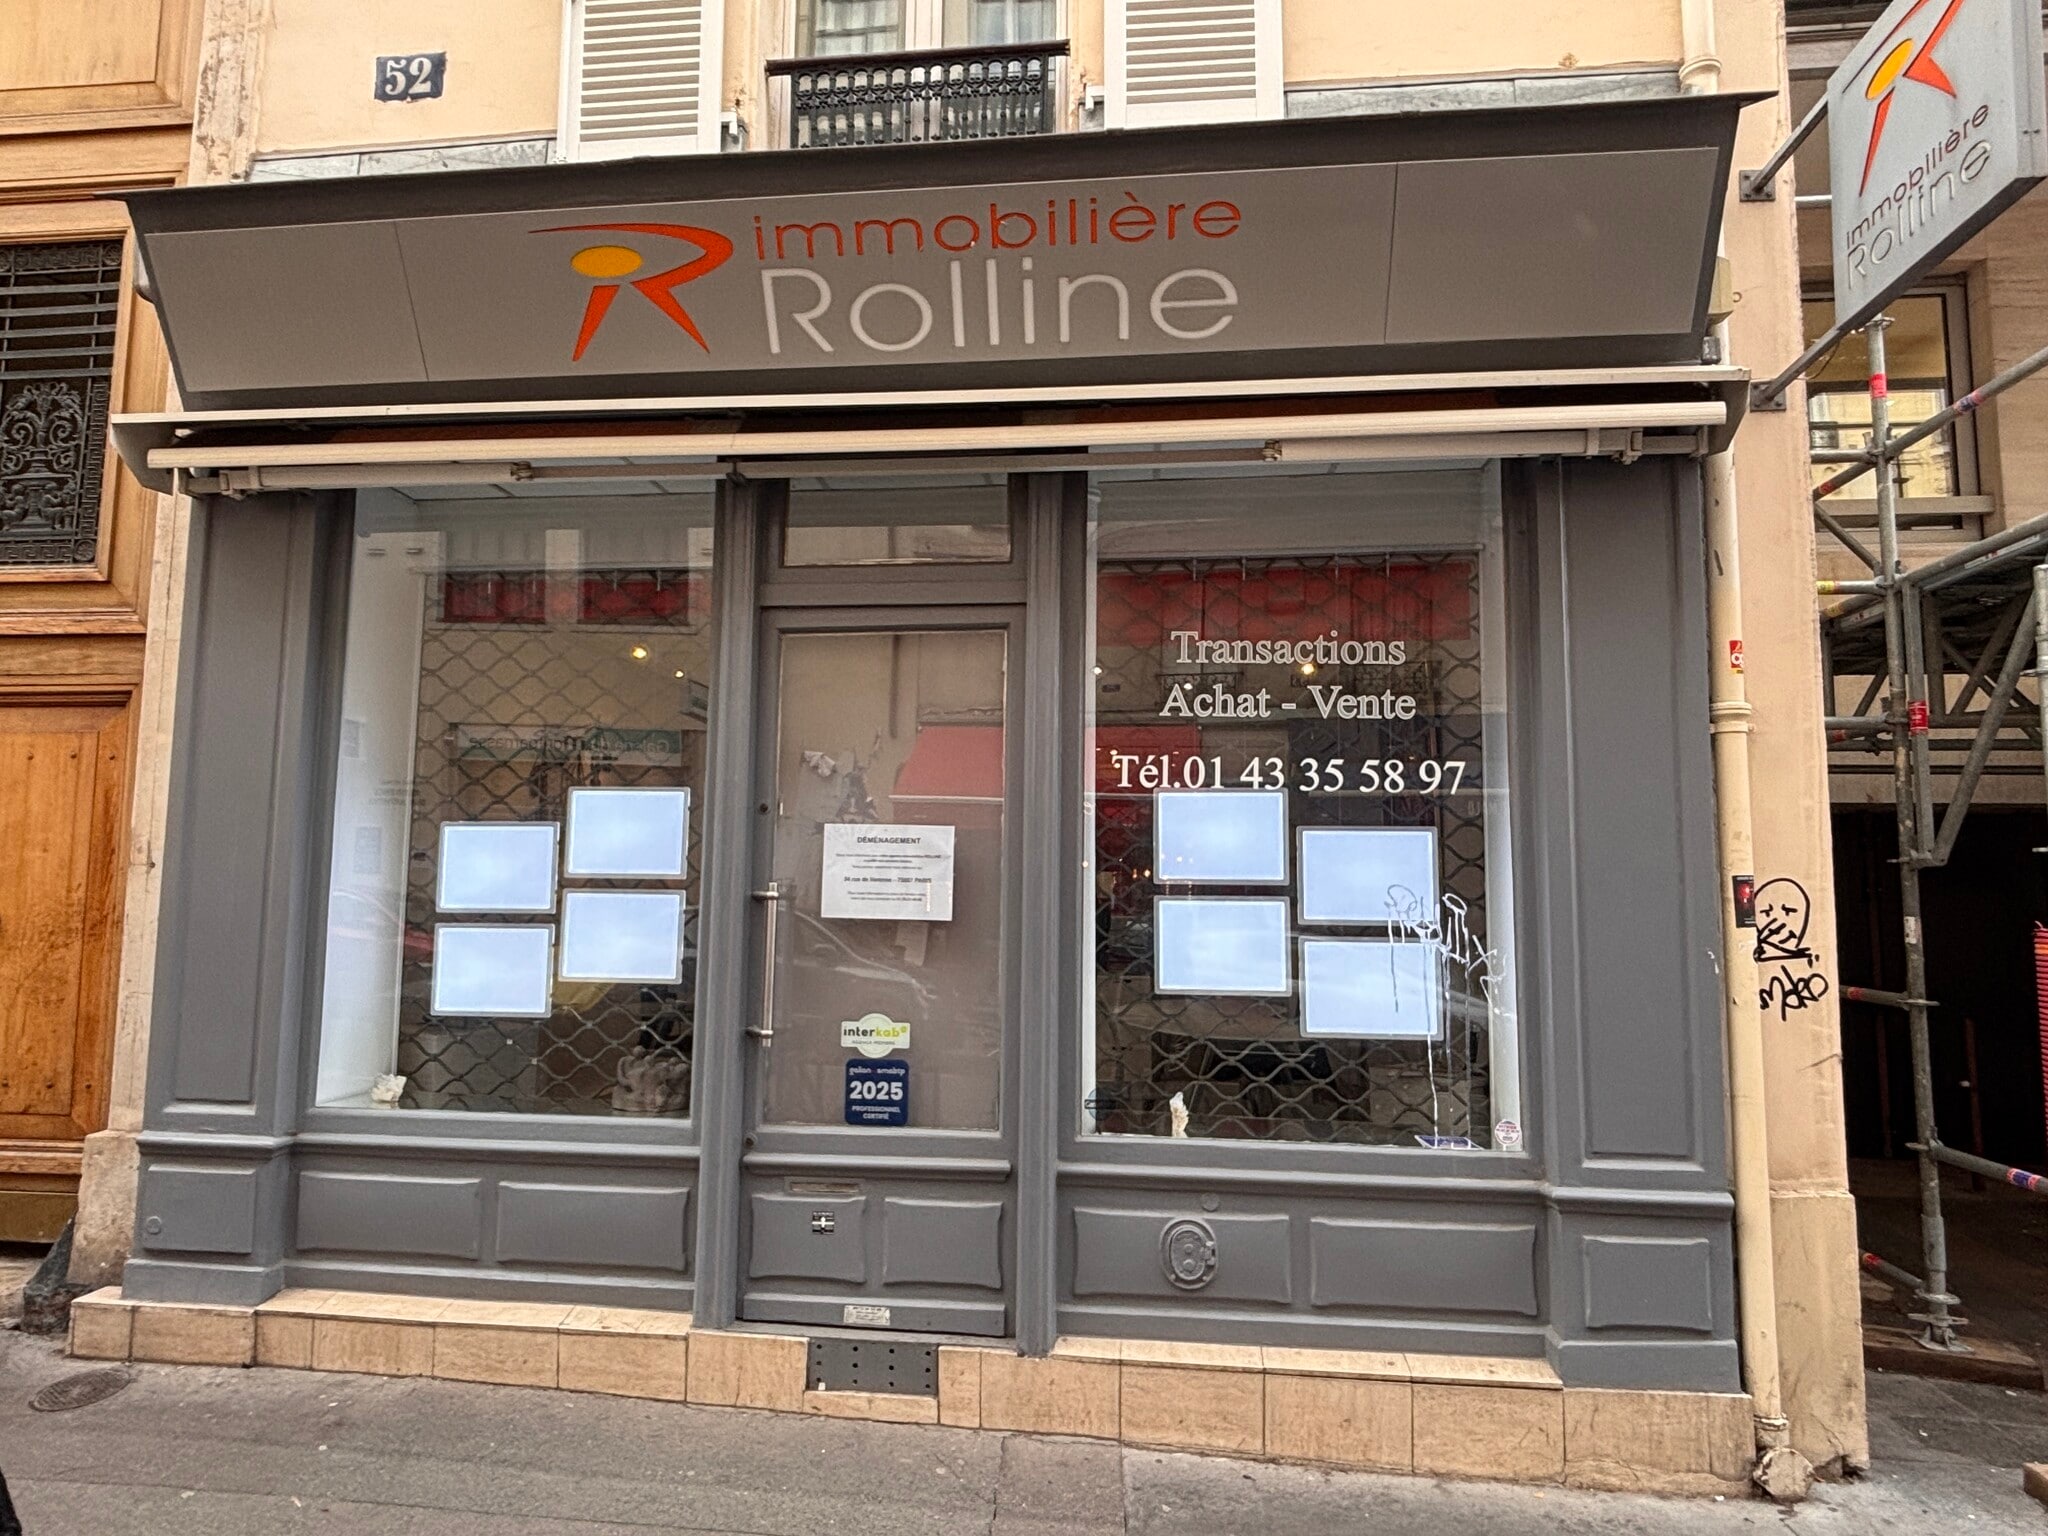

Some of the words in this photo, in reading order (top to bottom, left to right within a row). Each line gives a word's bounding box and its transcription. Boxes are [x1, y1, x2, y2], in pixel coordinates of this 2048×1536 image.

[384, 57, 432, 96] 52
[1846, 104, 1989, 250] immobilière
[753, 191, 1242, 260] immobilière
[1847, 139, 1992, 290] Rolline
[759, 255, 1240, 355] Rolline
[1169, 630, 1407, 666] Transactions
[1159, 683, 1272, 719] Achat
[1307, 684, 1417, 720] Vente
[1239, 756, 1285, 791] 43
[1299, 757, 1345, 793] 35
[1358, 758, 1406, 794] 58
[1418, 759, 1467, 796] 97
[856, 835, 922, 845] DÉMÉNAGEMENT
[849, 1080, 904, 1101] 2025
